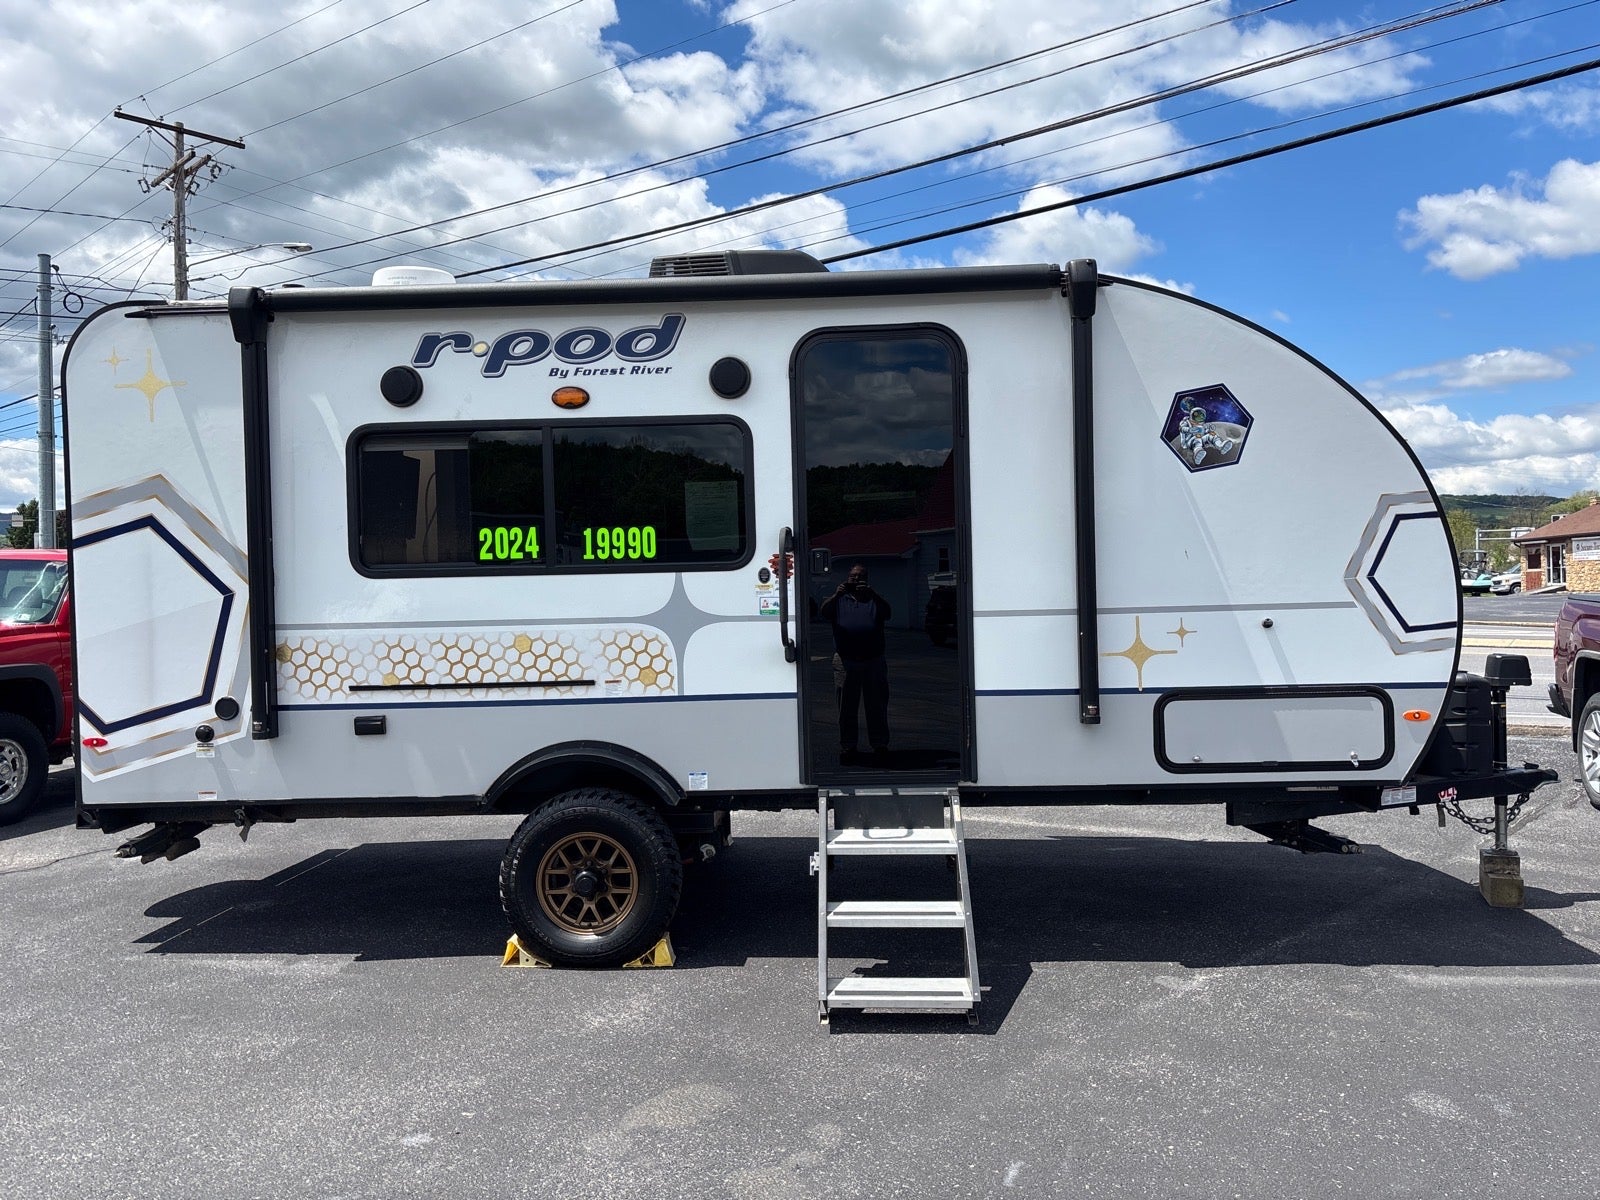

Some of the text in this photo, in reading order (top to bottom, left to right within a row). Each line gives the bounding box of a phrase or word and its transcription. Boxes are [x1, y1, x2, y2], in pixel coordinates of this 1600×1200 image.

[548, 365, 672, 379] By Forest River
[479, 526, 540, 560] 2024
[583, 526, 656, 560] 19990
